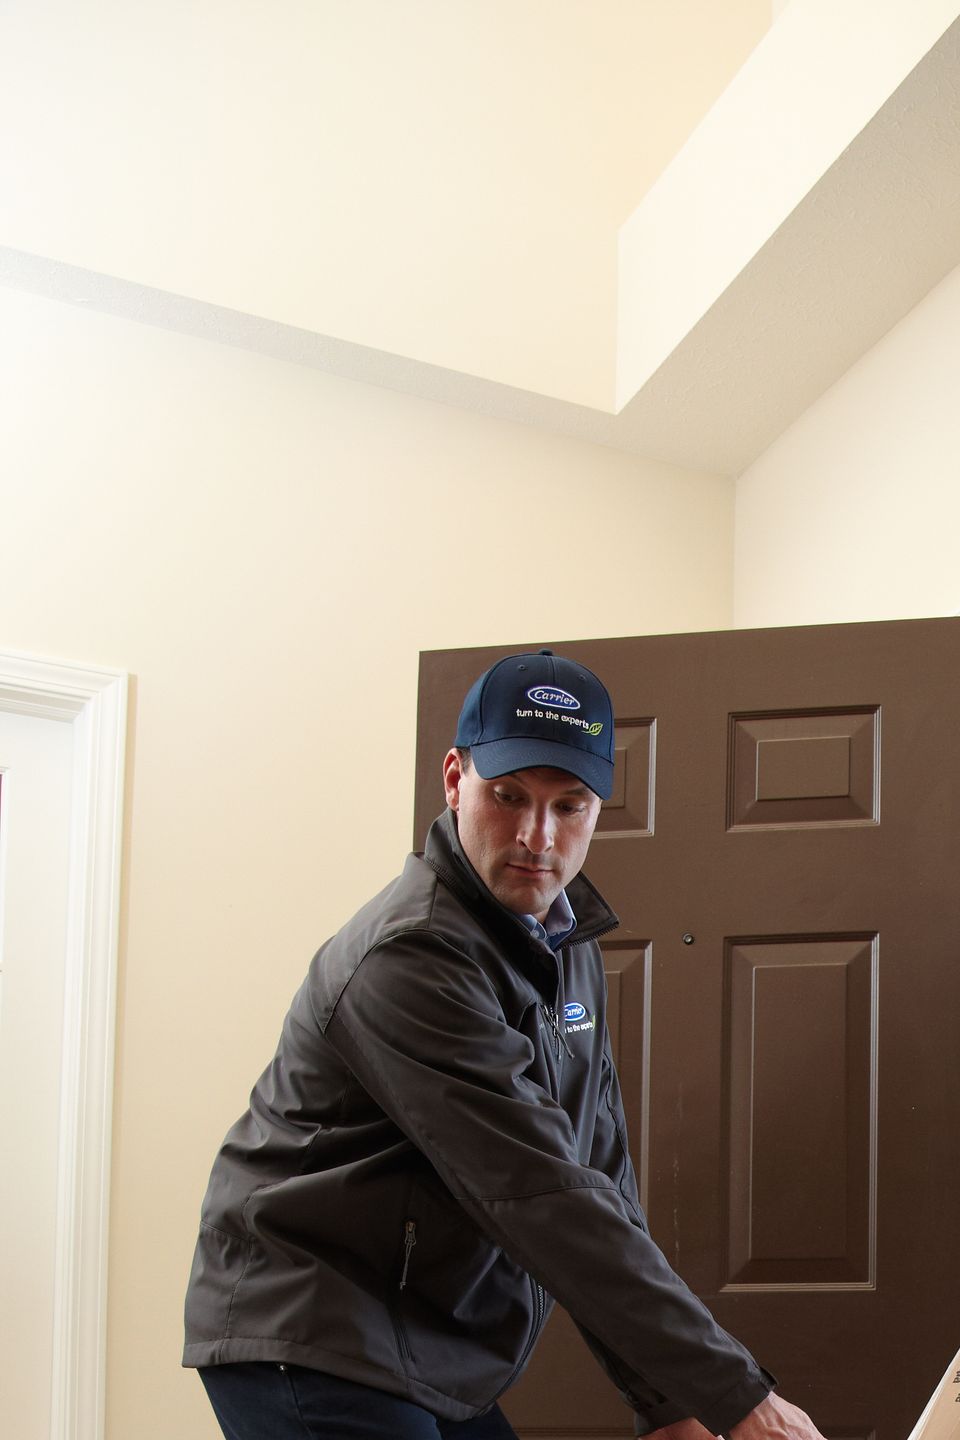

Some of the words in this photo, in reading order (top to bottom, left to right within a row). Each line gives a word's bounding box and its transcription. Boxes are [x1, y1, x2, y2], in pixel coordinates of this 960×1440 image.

[534, 690, 575, 705] Carrier
[516, 708, 533, 717] turn
[534, 709, 543, 717] to
[545, 711, 559, 720] the
[561, 715, 589, 729] experts
